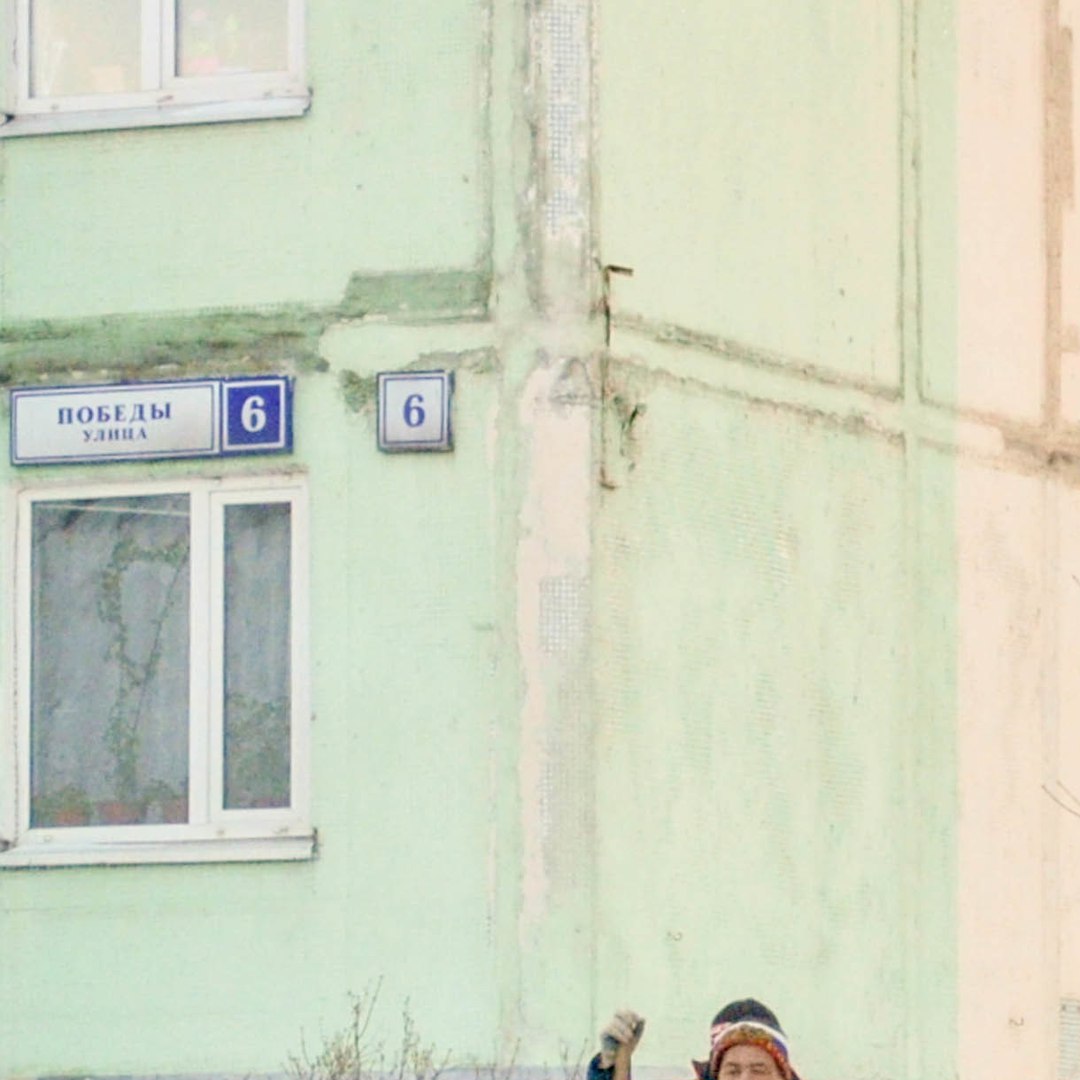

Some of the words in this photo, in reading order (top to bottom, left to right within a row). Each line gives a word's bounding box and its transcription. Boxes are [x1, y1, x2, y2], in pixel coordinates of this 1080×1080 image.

[57, 402, 171, 424] ПОБЕДЫ
[240, 395, 267, 432] 6
[402, 394, 426, 427] 6
[83, 427, 147, 442] УЛИЦА
